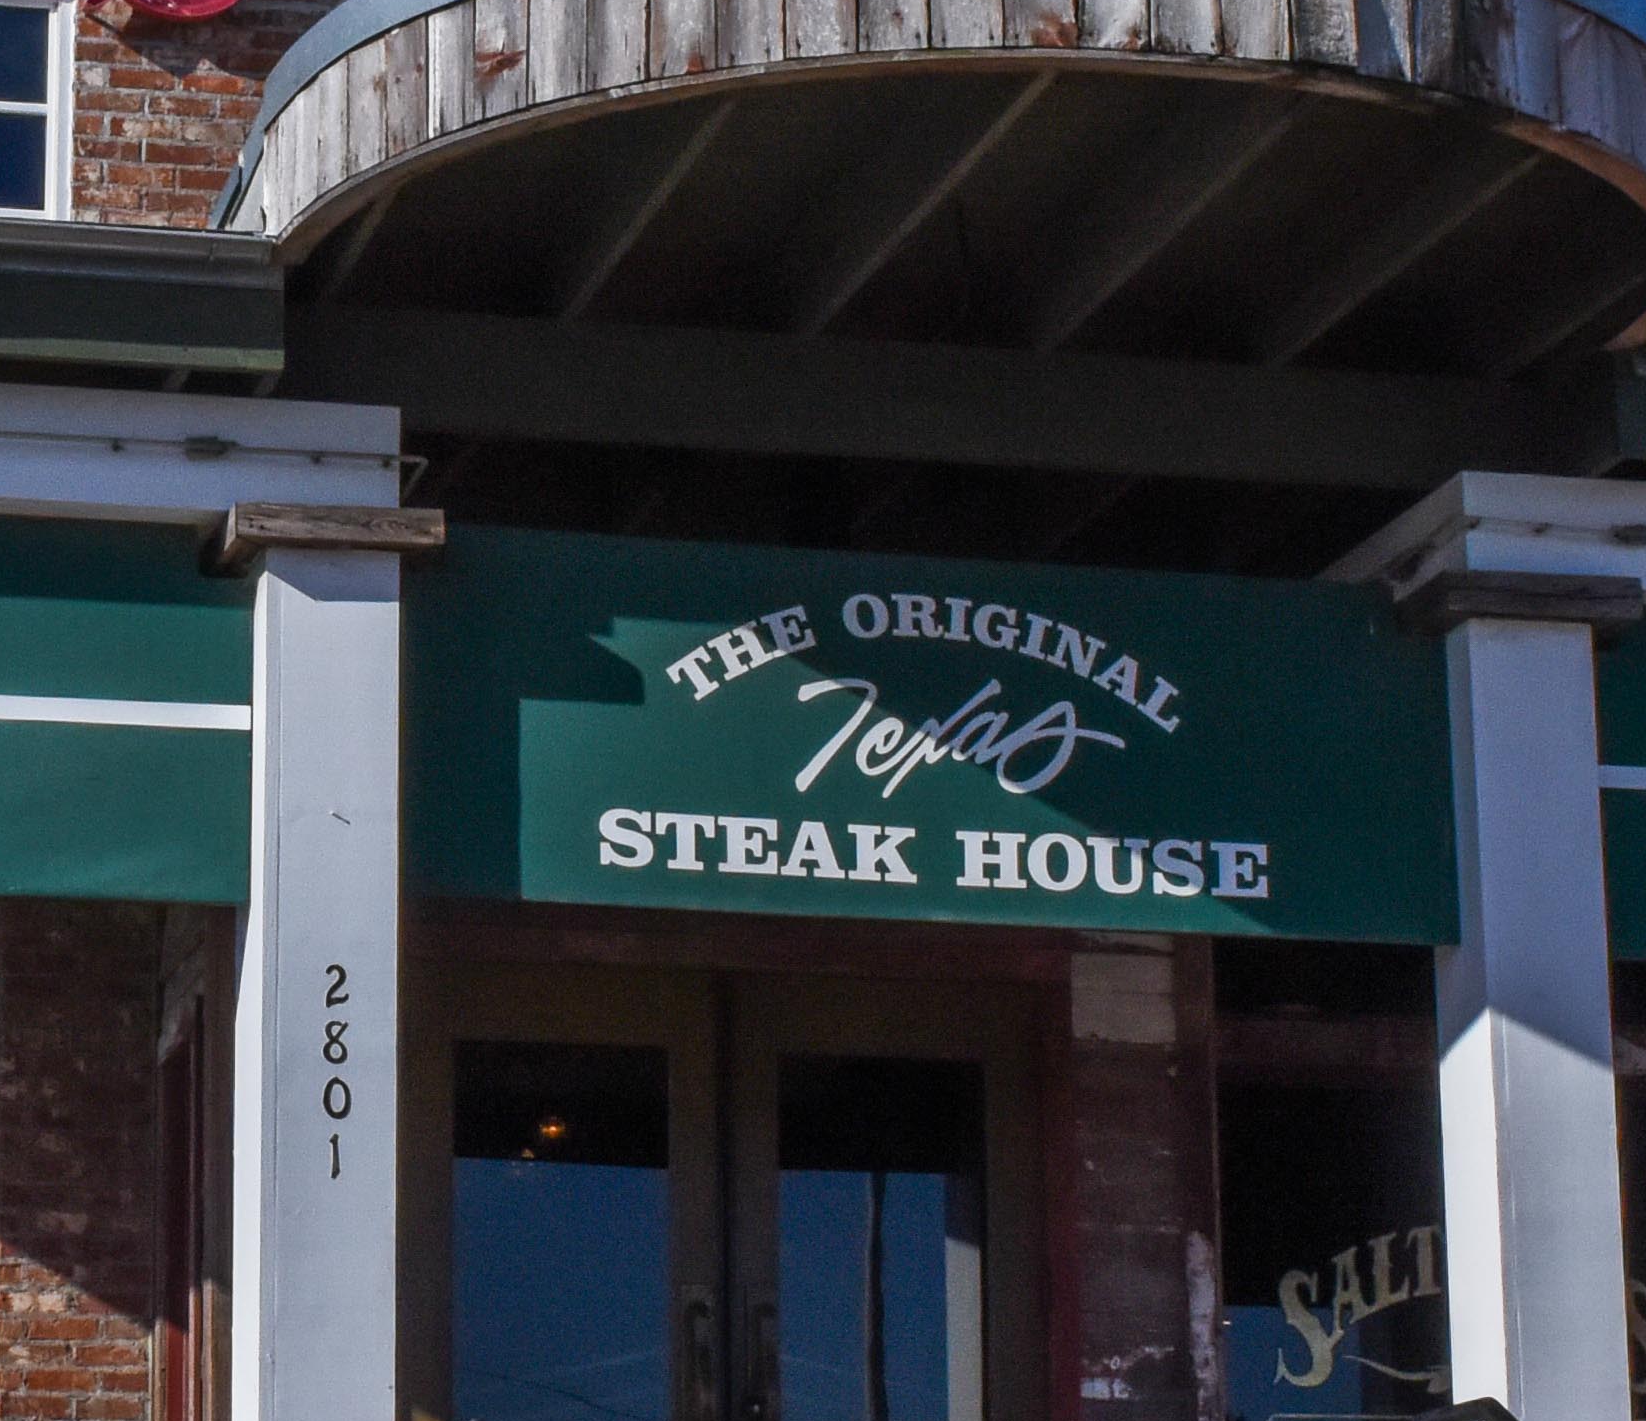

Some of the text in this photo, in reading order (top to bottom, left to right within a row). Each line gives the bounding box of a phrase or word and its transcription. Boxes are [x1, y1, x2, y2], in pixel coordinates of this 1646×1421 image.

[665, 592, 1186, 734] THE ORIGINAL
[795, 677, 1126, 799] Texas
[597, 808, 1270, 899] STEAK HOUSE
[322, 963, 353, 1180] 2801
